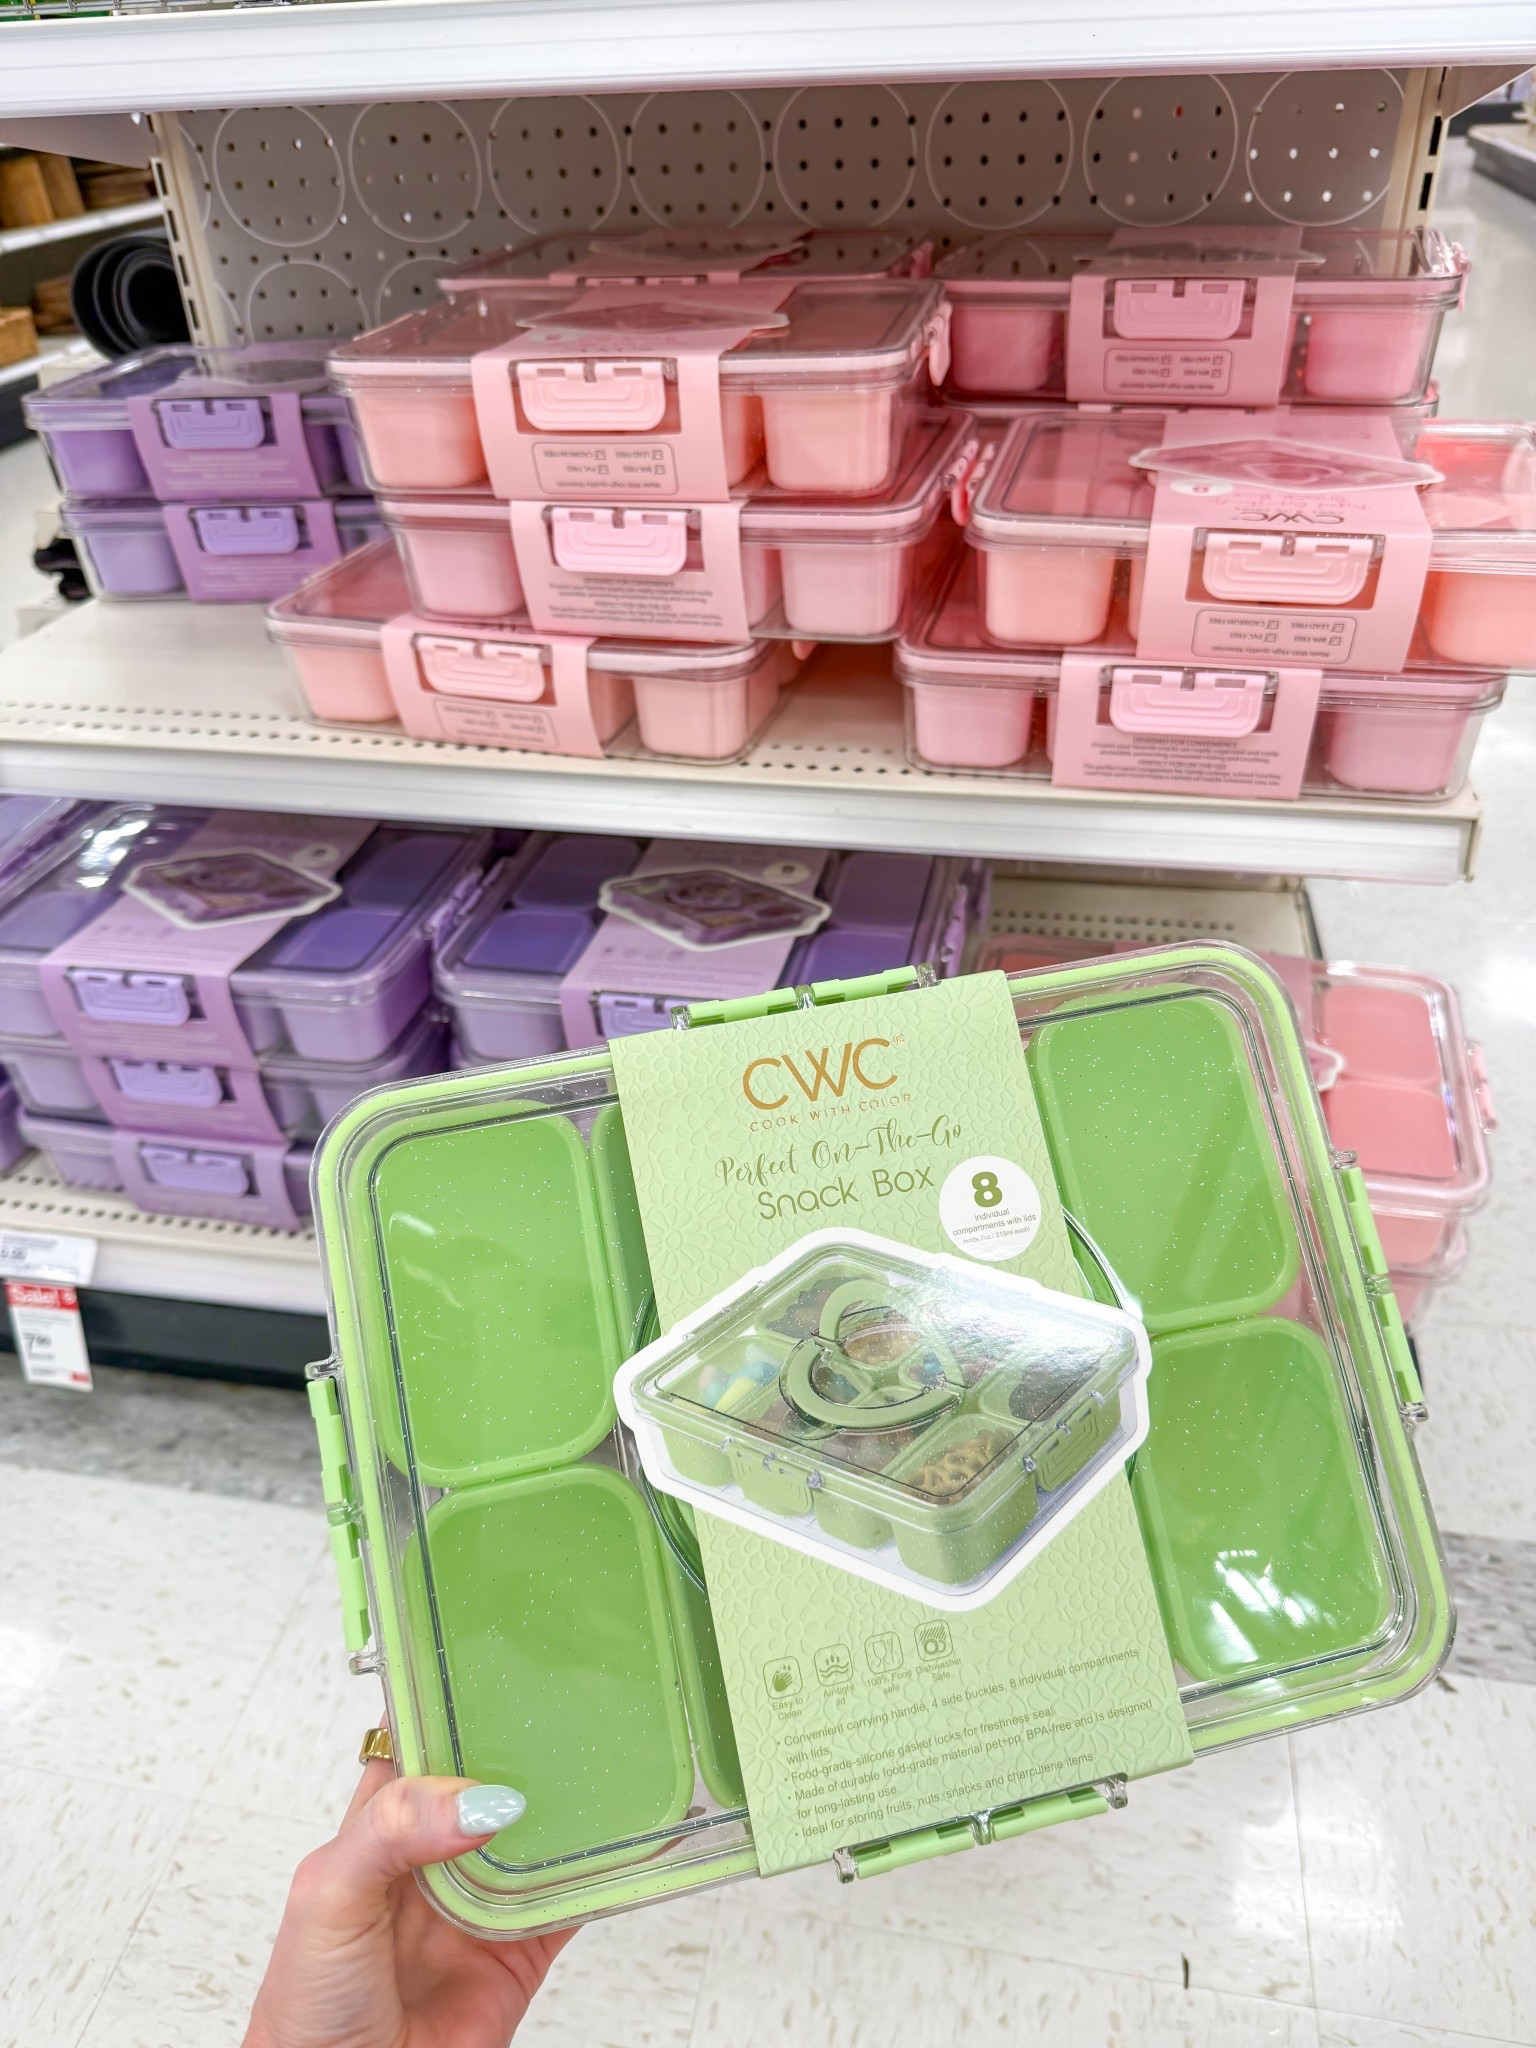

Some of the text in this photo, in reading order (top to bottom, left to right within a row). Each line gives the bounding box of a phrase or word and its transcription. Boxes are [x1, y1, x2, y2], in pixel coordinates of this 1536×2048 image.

[750, 1093, 912, 1132] COOK WITH COLOR
[714, 1114, 962, 1187] Perfect On-The-Go
[758, 1167, 935, 1220] Snack Box
[971, 1171, 1003, 1208] 8
[952, 1213, 1037, 1236] compartments with lids
[974, 1208, 1010, 1221] individual
[915, 1657, 962, 1675] Dishwasher
[931, 1670, 951, 1682] Safe
[866, 1669, 913, 1688] 100% Food
[784, 1647, 1140, 1747] Convenient carrying handle, 4 side buckles, 8 individual compartments
[823, 1683, 855, 1699] Air-tight
[883, 1685, 901, 1696] safe
[772, 1697, 804, 1711] Easy to
[836, 1697, 846, 1708] lid
[777, 1708, 803, 1721] Clean
[786, 1751, 809, 1765] with
[790, 1748, 896, 1783] Food-grade-silicone
[897, 1738, 933, 1757] gasket
[934, 1730, 962, 1746] locks
[963, 1726, 978, 1740] for
[979, 1712, 1030, 1735] freshness
[794, 1786, 825, 1801] Made
[827, 1782, 839, 1792] of
[840, 1771, 881, 1789] durable
[882, 1756, 940, 1778] food-grade
[941, 1742, 984, 1763] material
[1026, 1720, 1073, 1741] BPA-free
[1075, 1714, 1094, 1729] and
[1095, 1710, 1105, 1722] is
[1107, 1698, 1154, 1721] designed
[797, 1785, 901, 1820] for long-lasting use.
[802, 1823, 829, 1839] Ideal
[830, 1817, 846, 1832] for
[847, 1807, 884, 1827] storing
[946, 1780, 983, 1799] snacks
[984, 1775, 1005, 1789] and
[1007, 1761, 1064, 1783] charcuterie
[1066, 1751, 1097, 1768] items.
